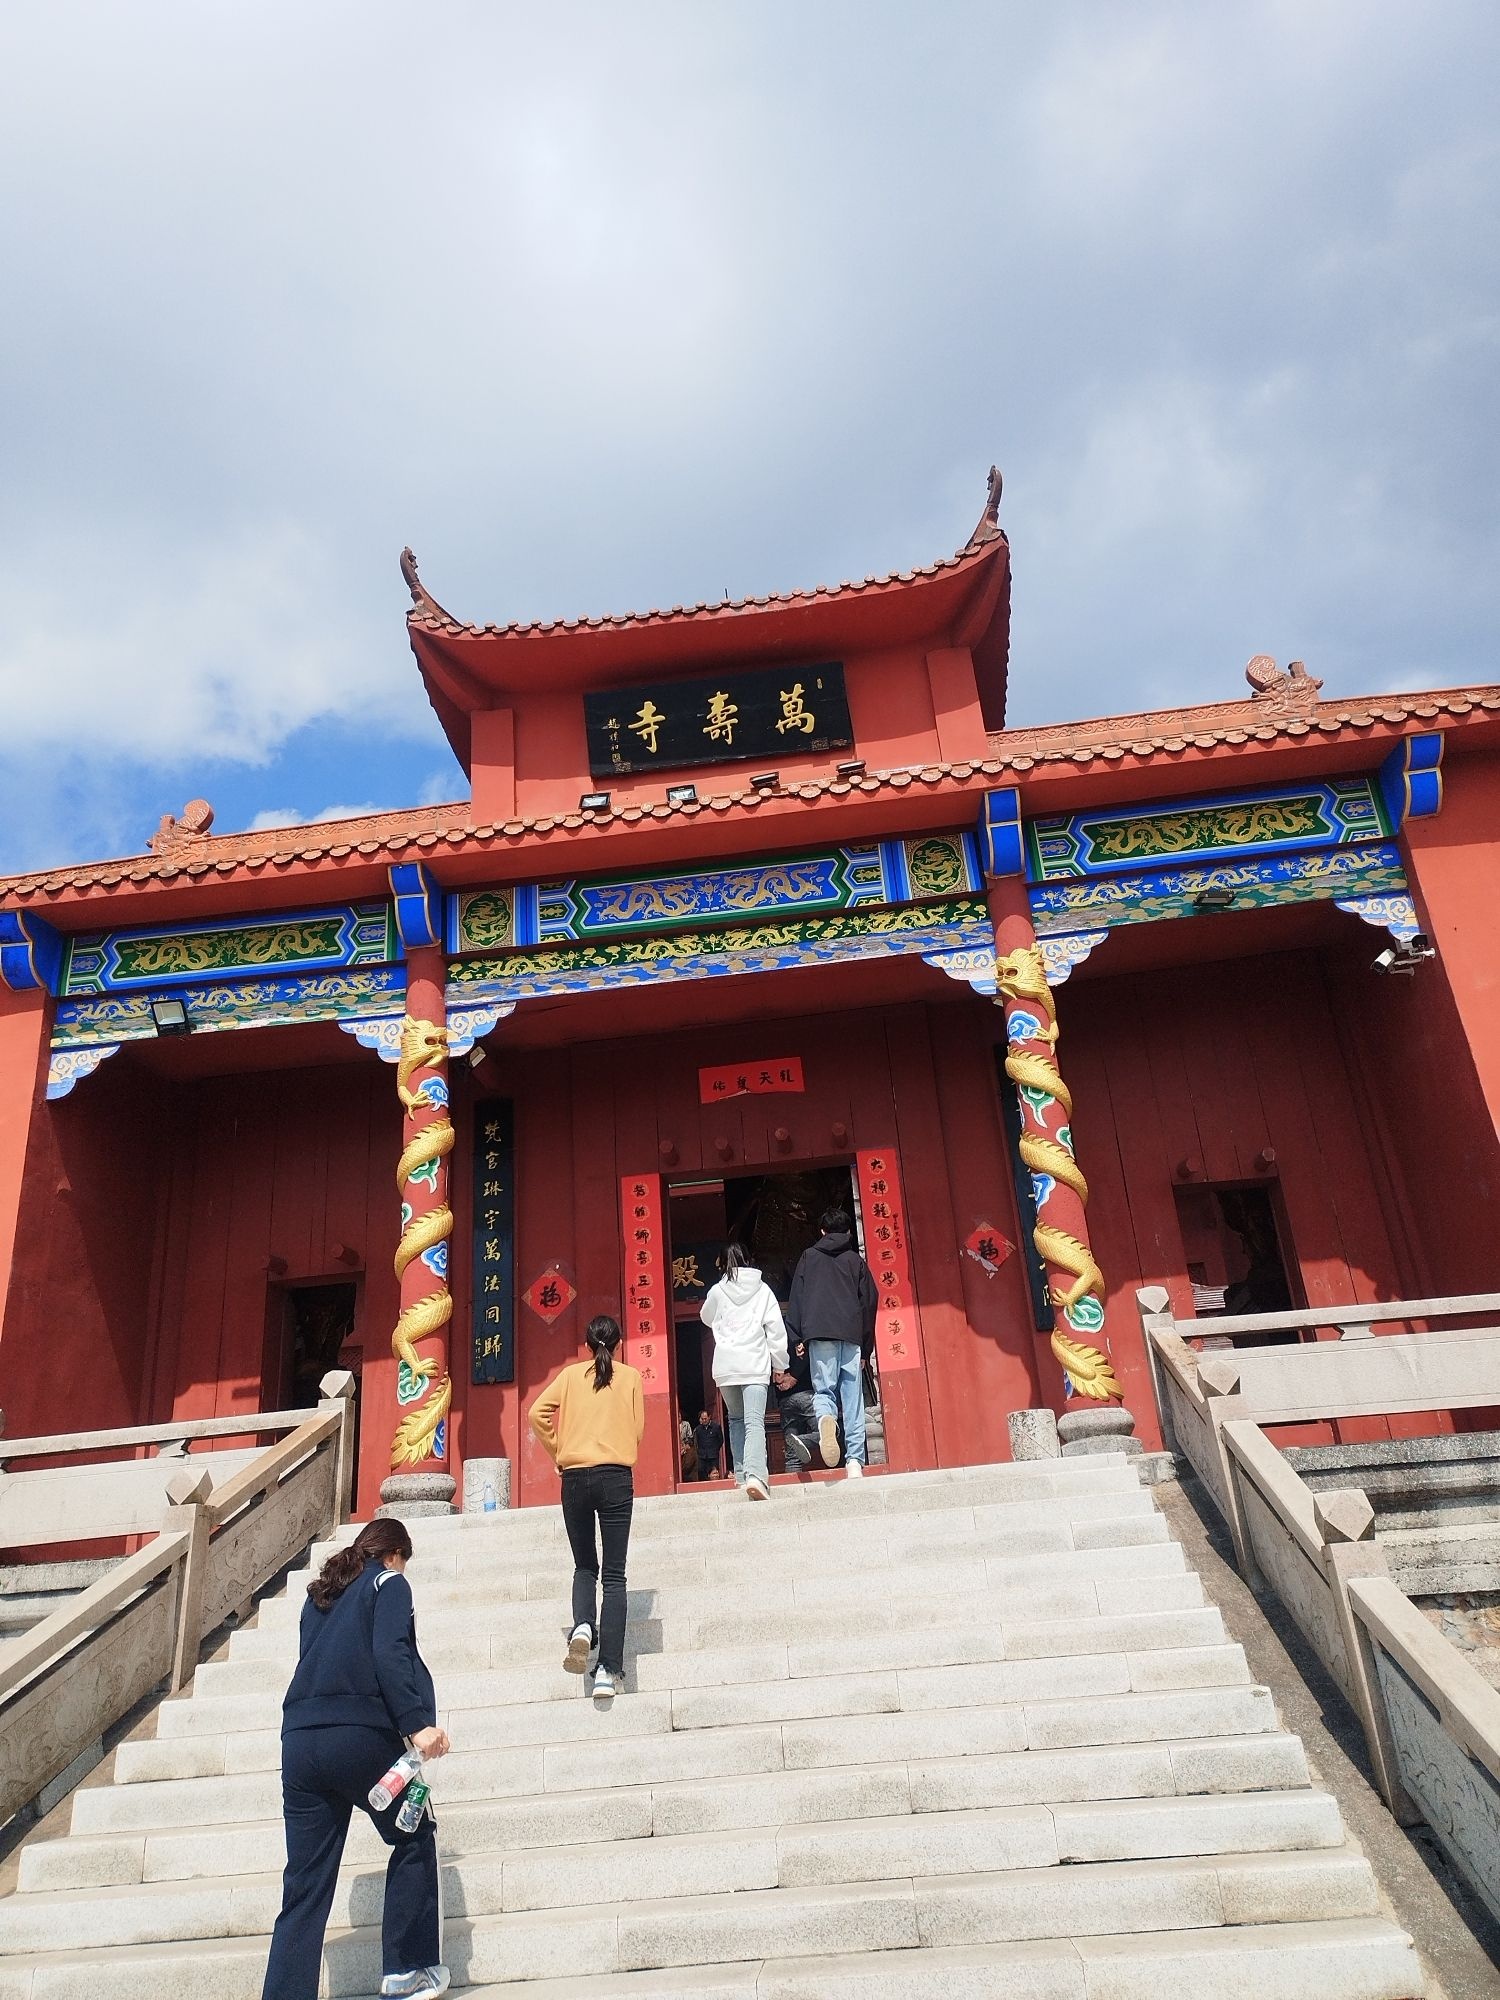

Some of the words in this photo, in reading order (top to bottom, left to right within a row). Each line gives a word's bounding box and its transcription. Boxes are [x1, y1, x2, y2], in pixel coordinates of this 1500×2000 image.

[628, 683, 815, 753] 萬壽寺
[540, 1281, 562, 1308] 福
